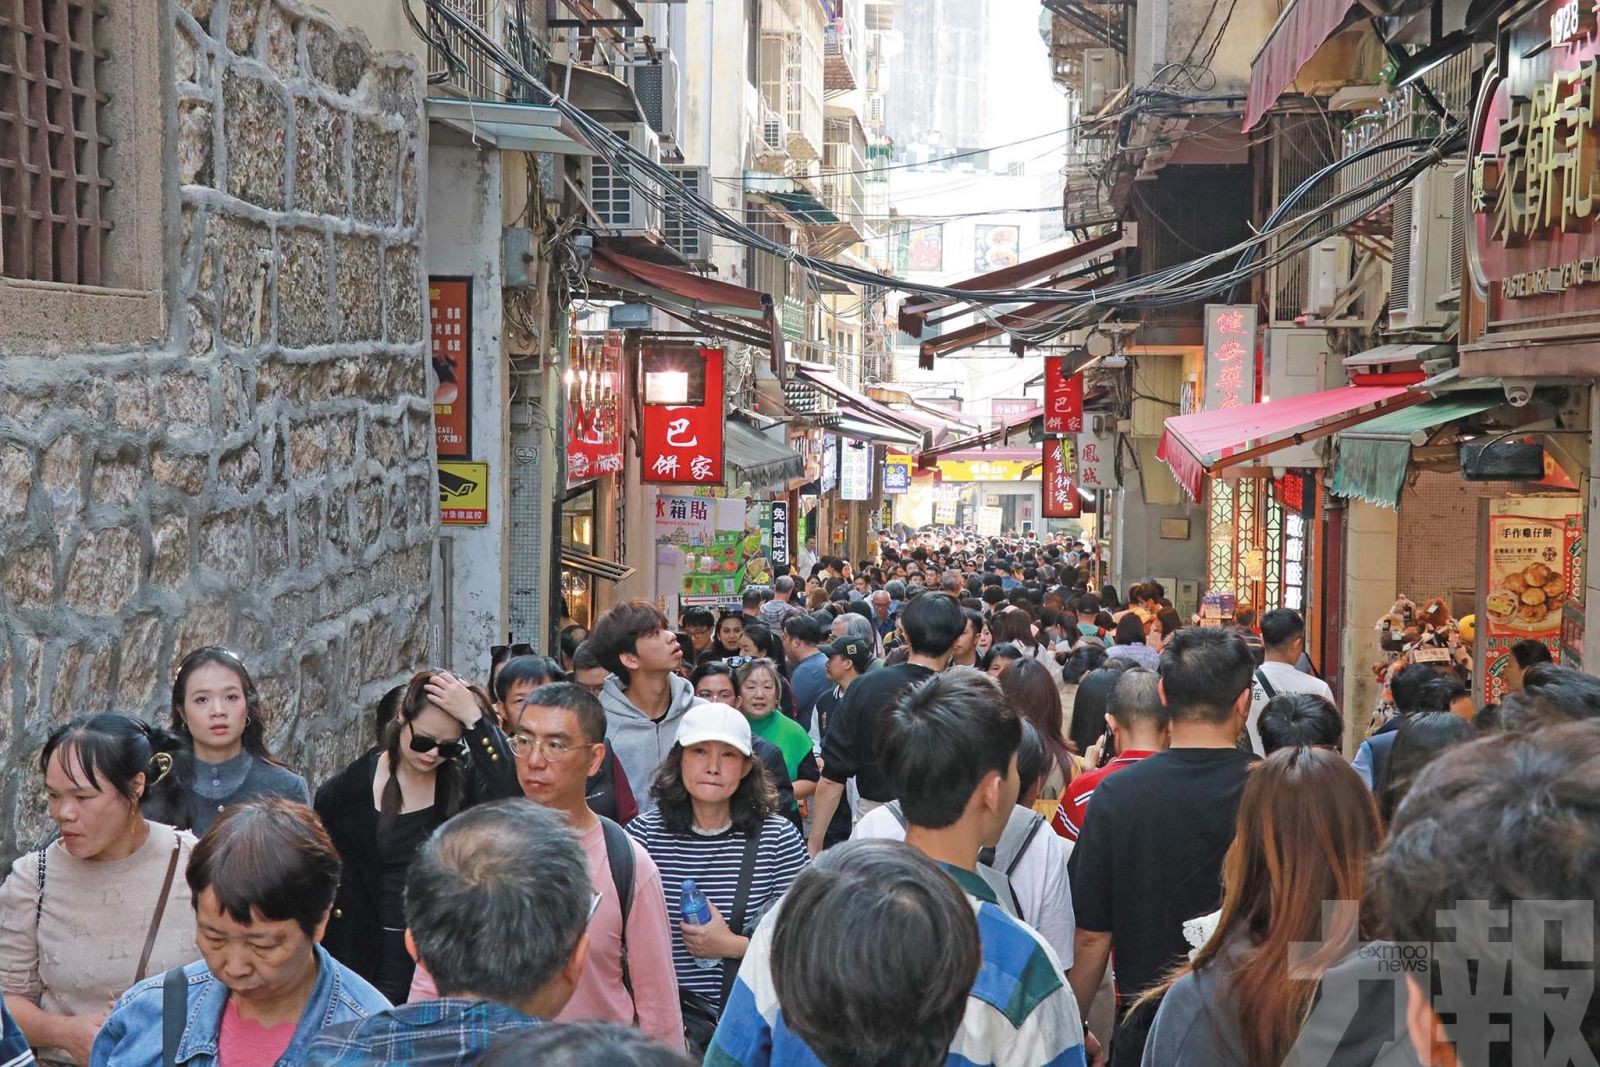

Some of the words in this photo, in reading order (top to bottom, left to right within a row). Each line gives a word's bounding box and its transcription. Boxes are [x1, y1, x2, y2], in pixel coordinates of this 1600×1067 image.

[1501, 266, 1551, 299] PASTELARIA
[1559, 257, 1585, 288] YENG
[1081, 443, 1101, 485] 鳳城
[773, 507, 785, 562] 免費試吃
